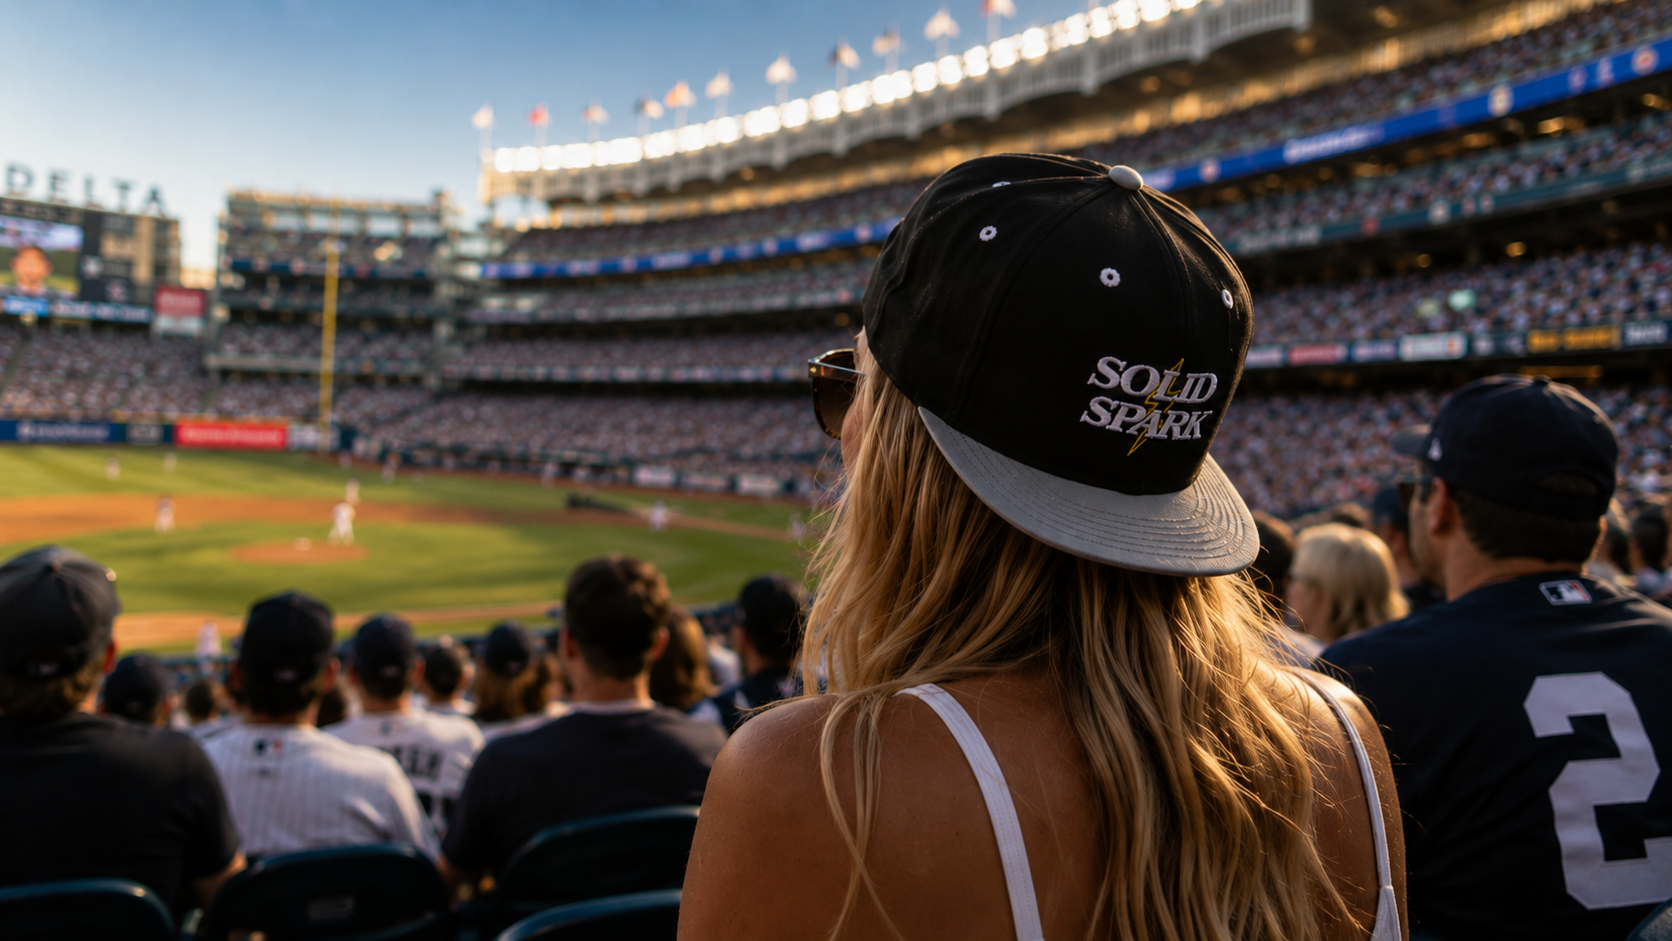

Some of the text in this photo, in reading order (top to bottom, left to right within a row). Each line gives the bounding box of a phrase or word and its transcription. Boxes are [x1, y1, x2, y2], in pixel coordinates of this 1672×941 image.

[7, 163, 166, 215] DELTA
[1087, 356, 1218, 404] SOLID
[1079, 395, 1213, 441] SPARK
[1523, 671, 1672, 911] 2
